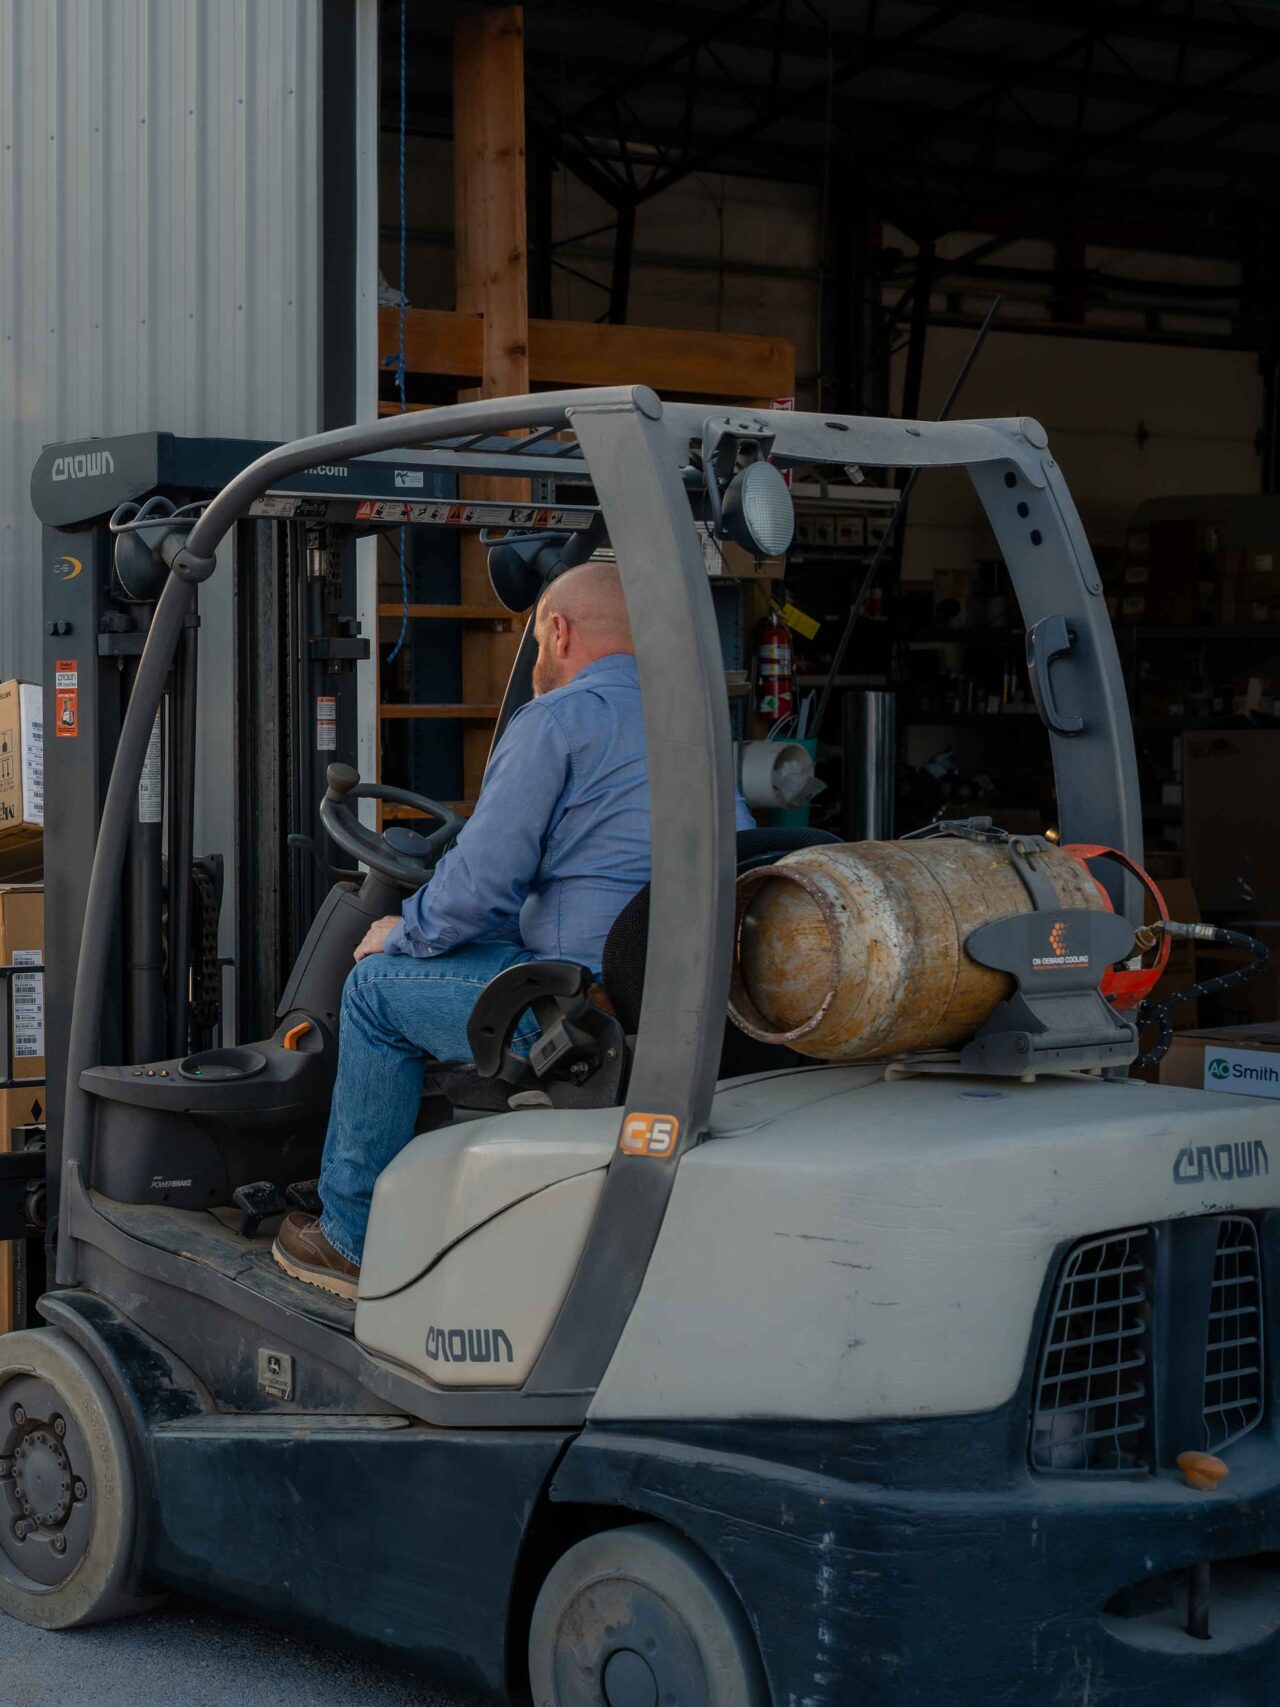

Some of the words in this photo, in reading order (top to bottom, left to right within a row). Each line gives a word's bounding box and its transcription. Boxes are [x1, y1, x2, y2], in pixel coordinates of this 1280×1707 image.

[51, 451, 115, 481] CROWN
[1032, 956, 1065, 965] ON-DEMAND
[1065, 955, 1089, 963] COOLING
[1232, 1064, 1280, 1082] Smith
[624, 1121, 673, 1150] C-5
[1172, 1140, 1269, 1185] CROWN
[151, 1180, 192, 1188] POWERBRAKE
[425, 1325, 513, 1362] CROWN
